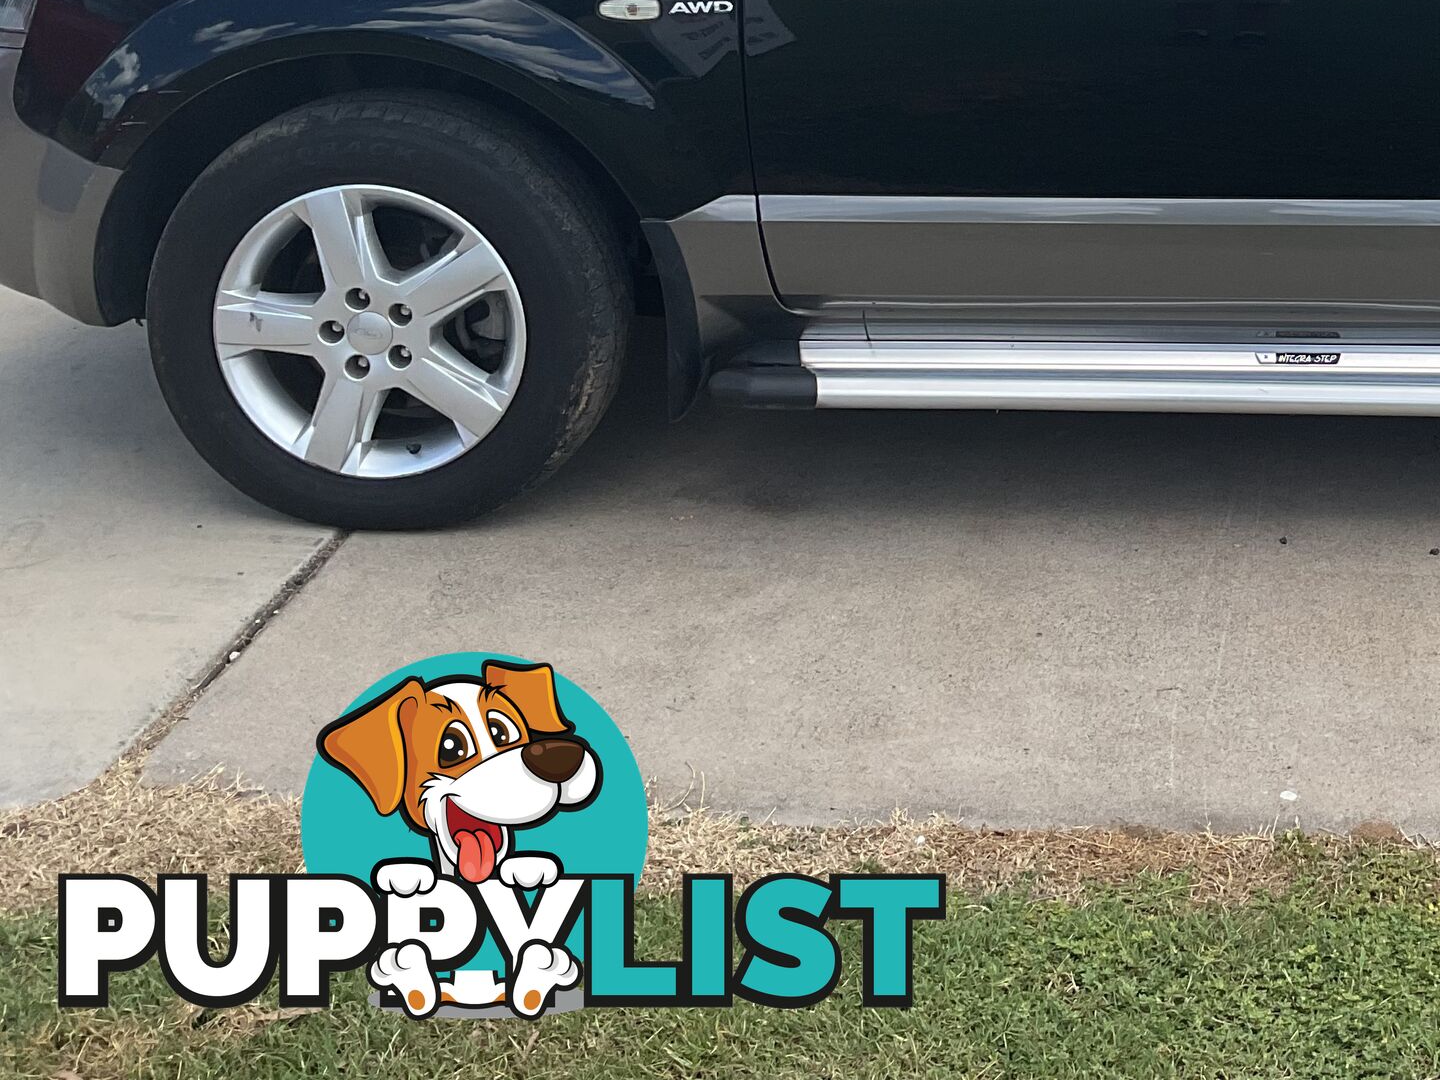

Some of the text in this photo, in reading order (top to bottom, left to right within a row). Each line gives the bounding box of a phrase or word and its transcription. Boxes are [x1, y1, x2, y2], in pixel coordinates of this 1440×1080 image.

[669, 0, 734, 15] AWD
[1278, 353, 1337, 363] INTEGRA STEP
